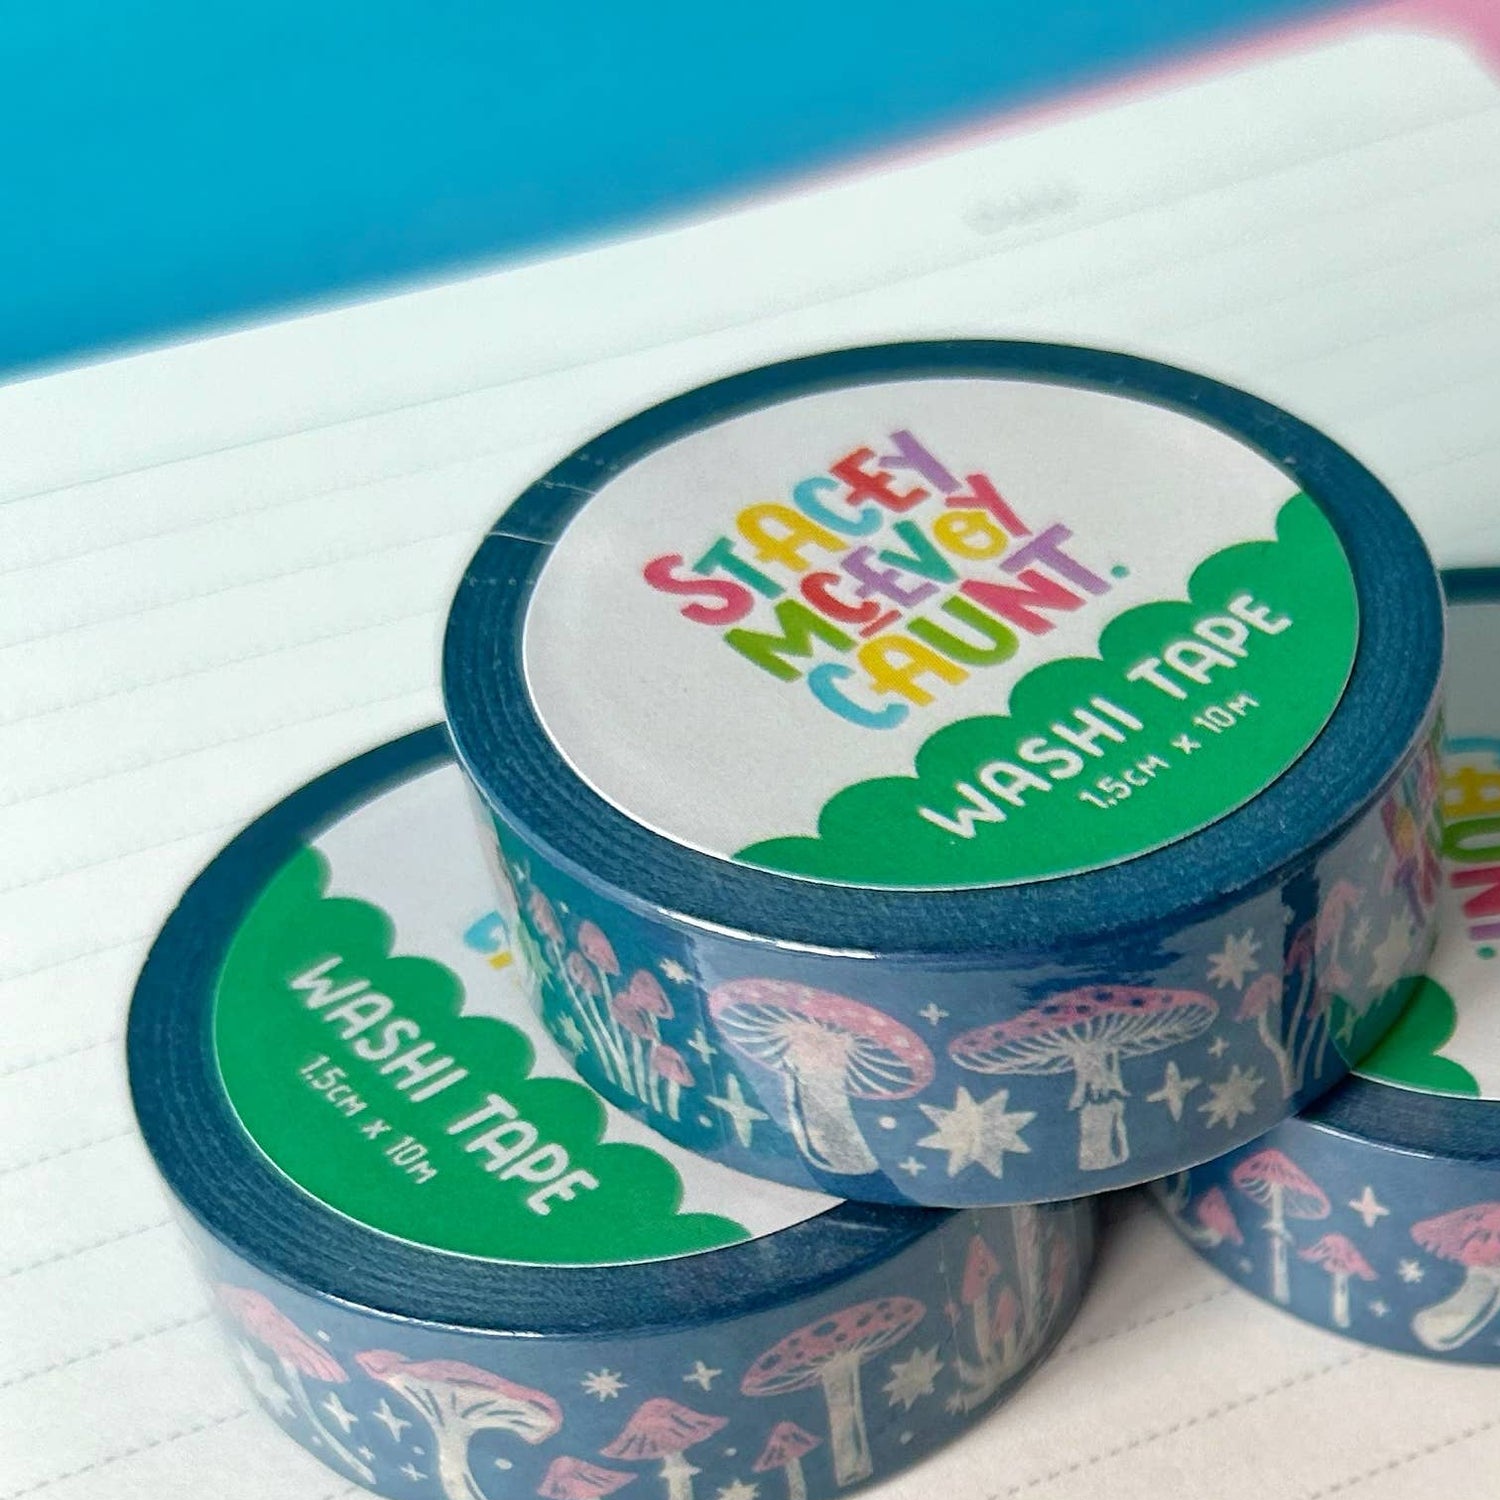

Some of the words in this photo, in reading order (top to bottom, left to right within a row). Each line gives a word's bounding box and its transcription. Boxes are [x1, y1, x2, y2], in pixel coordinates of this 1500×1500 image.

[643, 429, 962, 627] STACEY
[918, 695, 1144, 840] WASHI
[1126, 593, 1293, 700] TAPE
[288, 955, 469, 1103] WASHI
[445, 1091, 600, 1216] TAPE
